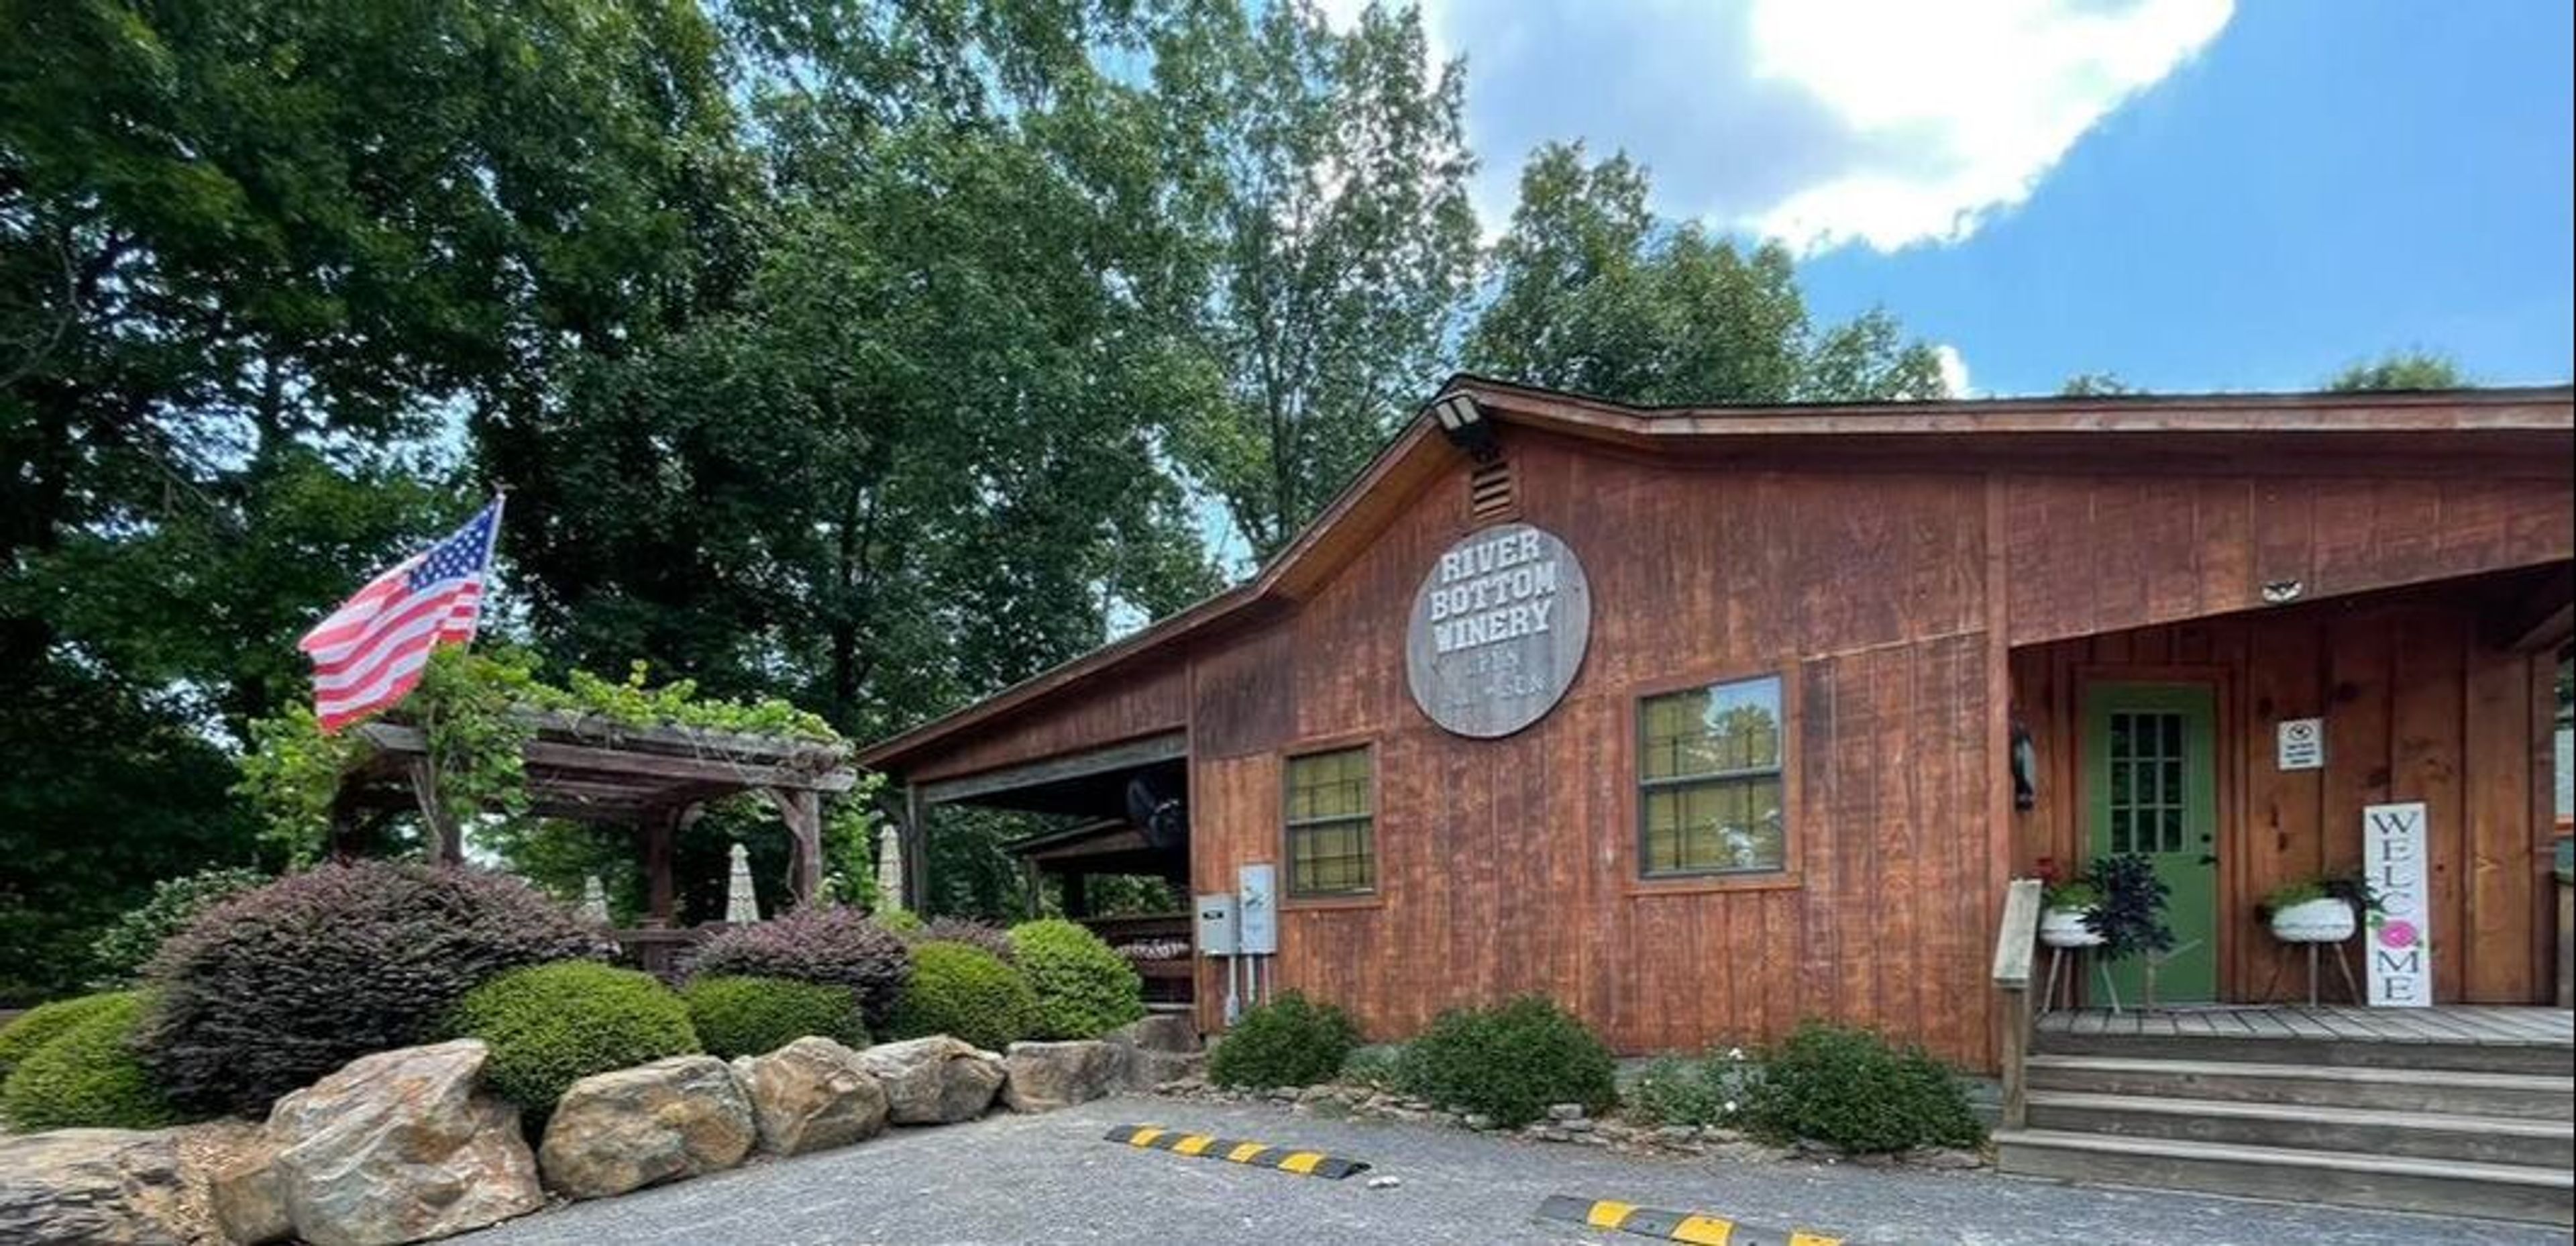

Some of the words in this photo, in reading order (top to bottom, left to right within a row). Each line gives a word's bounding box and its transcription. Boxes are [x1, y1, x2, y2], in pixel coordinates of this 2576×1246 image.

[1442, 529, 1542, 582] RIVER
[1430, 562, 1557, 621] BOTTOM
[1433, 600, 1552, 653] WINERY
